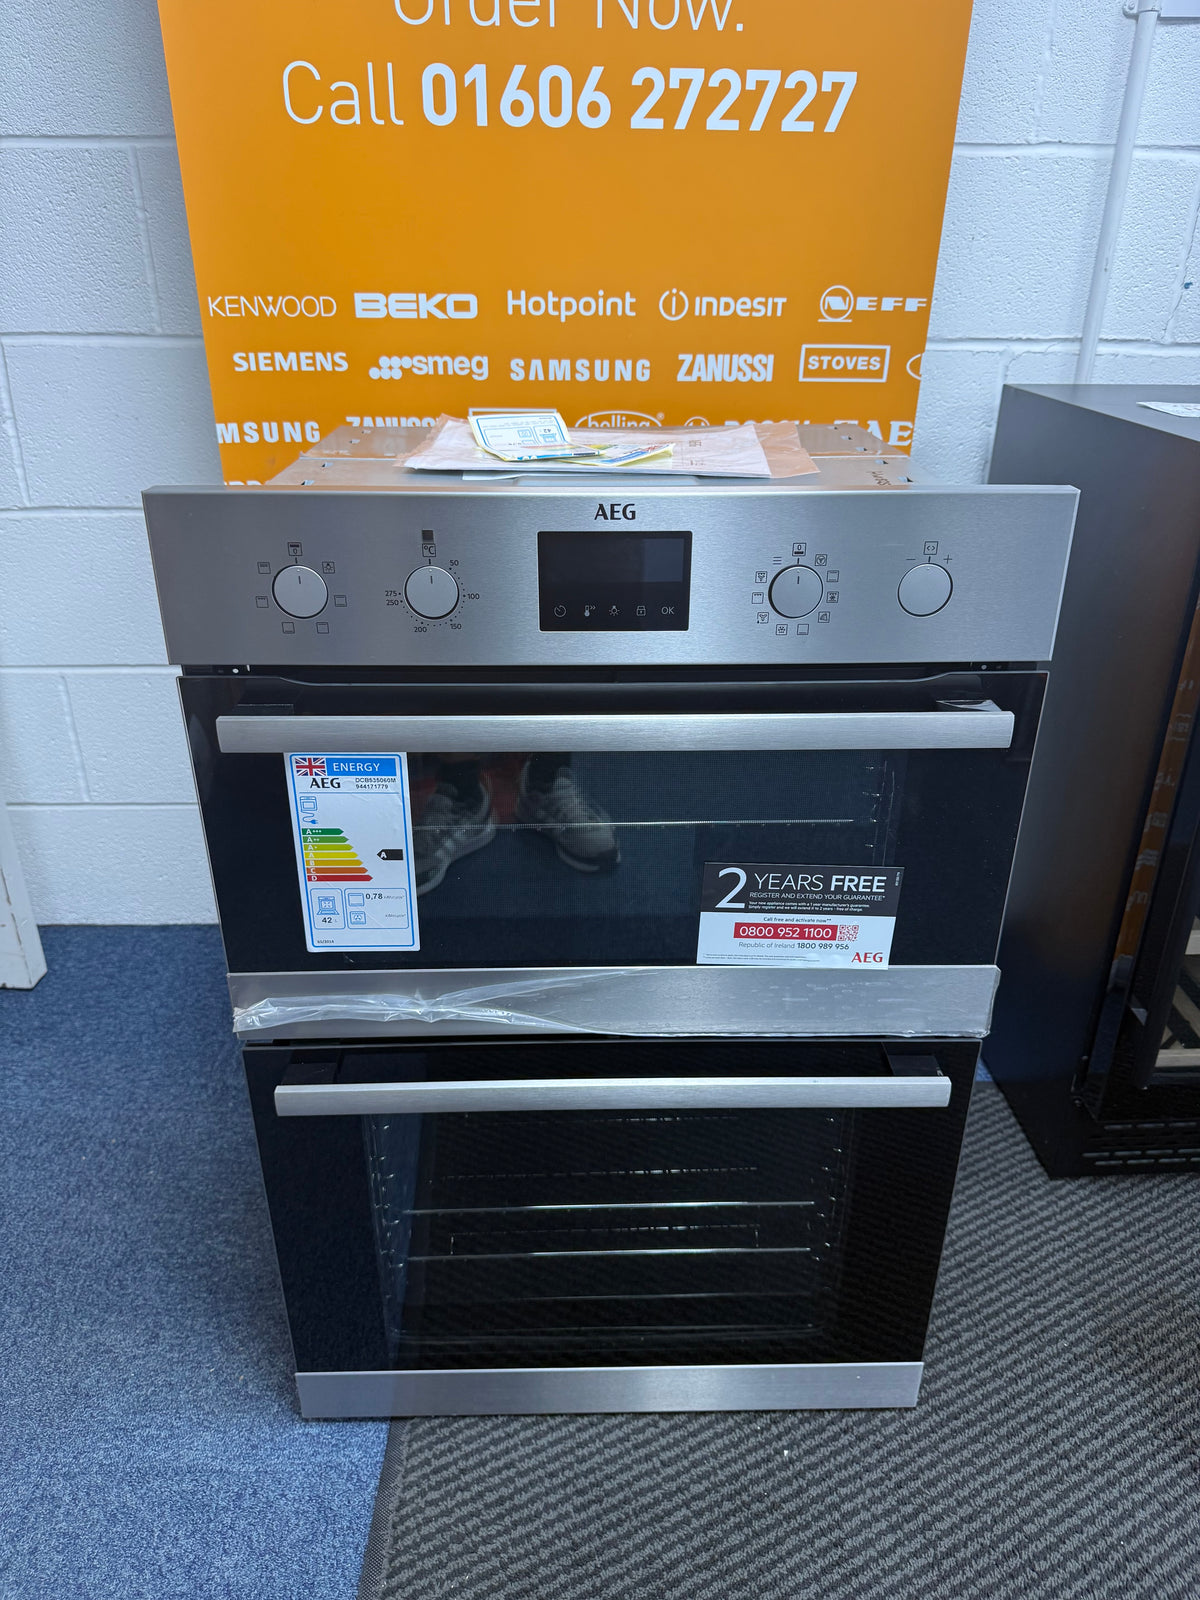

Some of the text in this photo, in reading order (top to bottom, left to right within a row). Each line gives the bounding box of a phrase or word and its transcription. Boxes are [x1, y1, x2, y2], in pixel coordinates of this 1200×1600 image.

[282, 60, 858, 133] Call 01606 272727
[208, 296, 337, 318] KENWOOD
[354, 292, 478, 320] BEKO
[507, 289, 637, 323] Hotpoint
[822, 293, 928, 314] NEFF
[232, 351, 348, 372] SIEMENS
[411, 355, 489, 381] smeg
[510, 358, 650, 382] SAMSUNG
[676, 353, 775, 383] ZANUSSI
[807, 355, 881, 371] STOVES
[593, 503, 637, 521] AEG
[423, 544, 435, 556] °C
[449, 559, 459, 567] 50
[661, 606, 675, 615] OK
[333, 762, 380, 772] ENERGY
[310, 777, 341, 789] AEG
[715, 867, 747, 909] 2
[754, 872, 824, 892] YEARS
[830, 875, 887, 893] FREE
[365, 892, 383, 900] 0,78
[749, 891, 780, 899] REGISTER
[739, 926, 832, 939] 0800 952 1100
[738, 941, 765, 950] Republic
[851, 951, 883, 964] AEG
